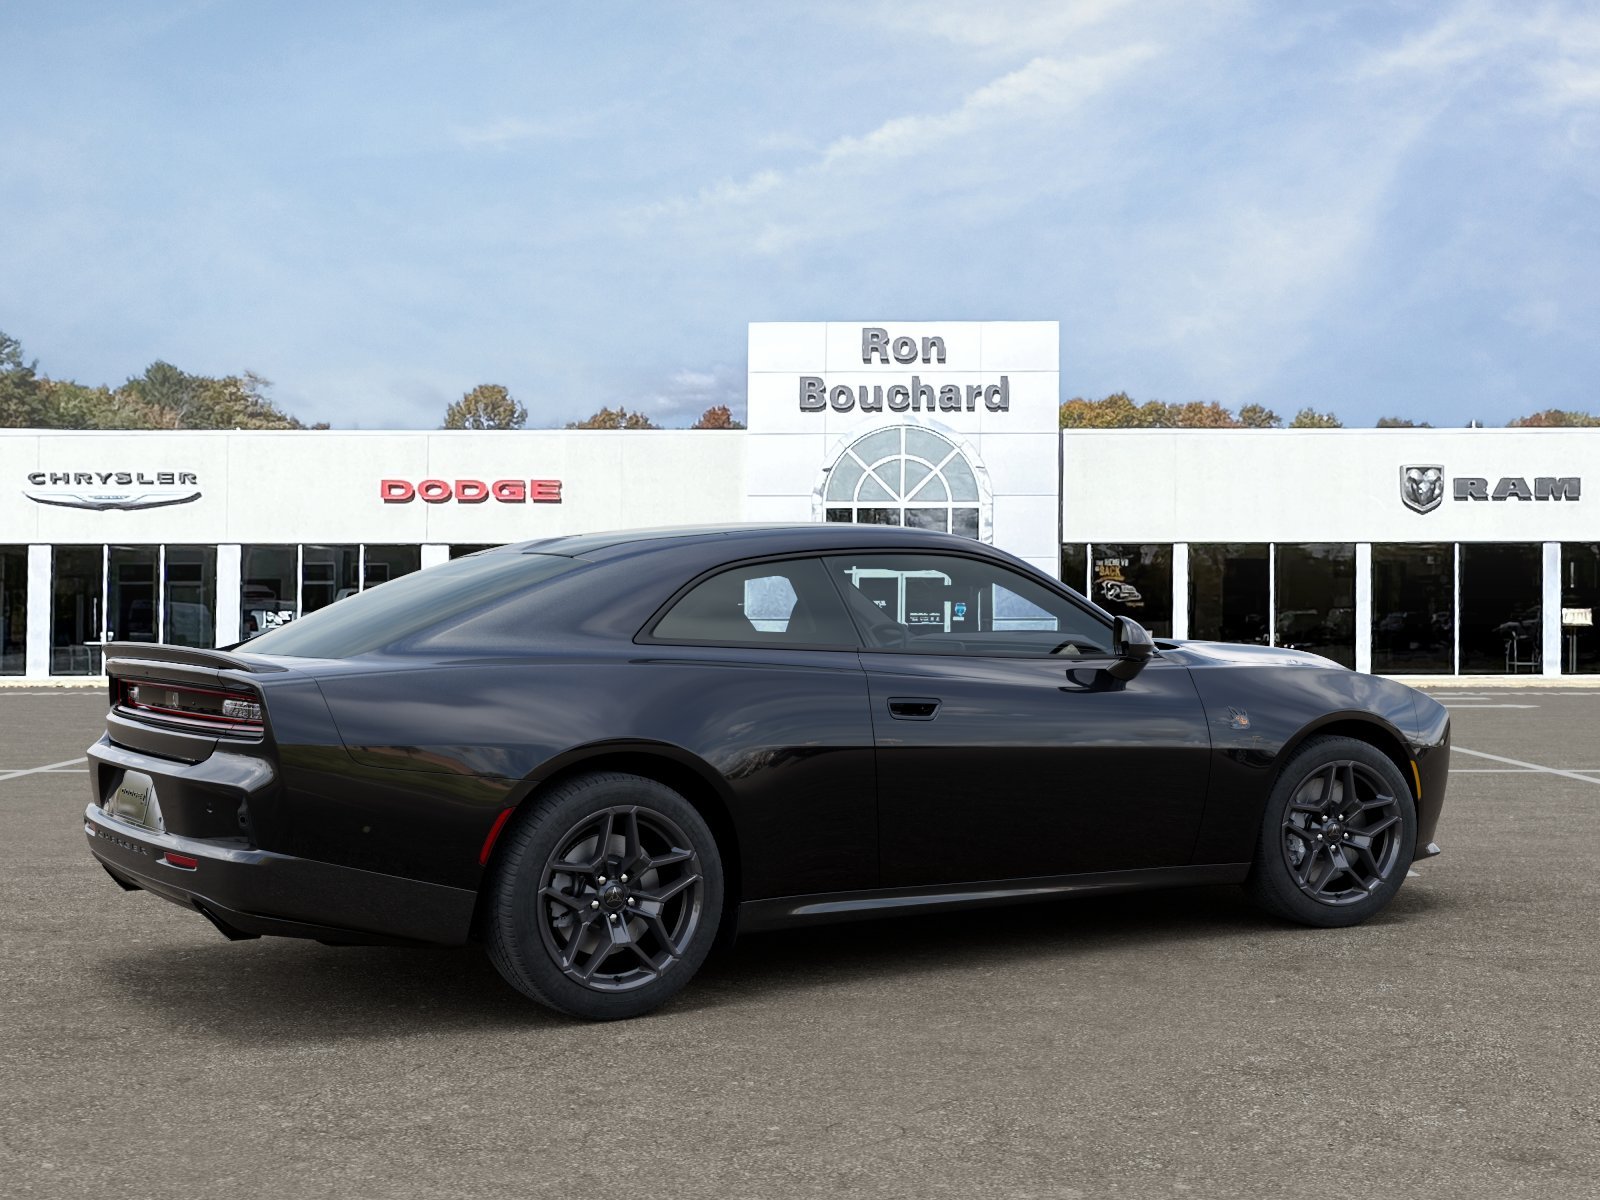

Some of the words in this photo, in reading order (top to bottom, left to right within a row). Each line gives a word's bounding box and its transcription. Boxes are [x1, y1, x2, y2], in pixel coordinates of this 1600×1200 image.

[861, 327, 947, 364] Ron
[799, 375, 1010, 413] Bouchard
[27, 472, 198, 486] CHRYSLER
[380, 479, 563, 504] DODGE
[1452, 477, 1582, 502] RAM
